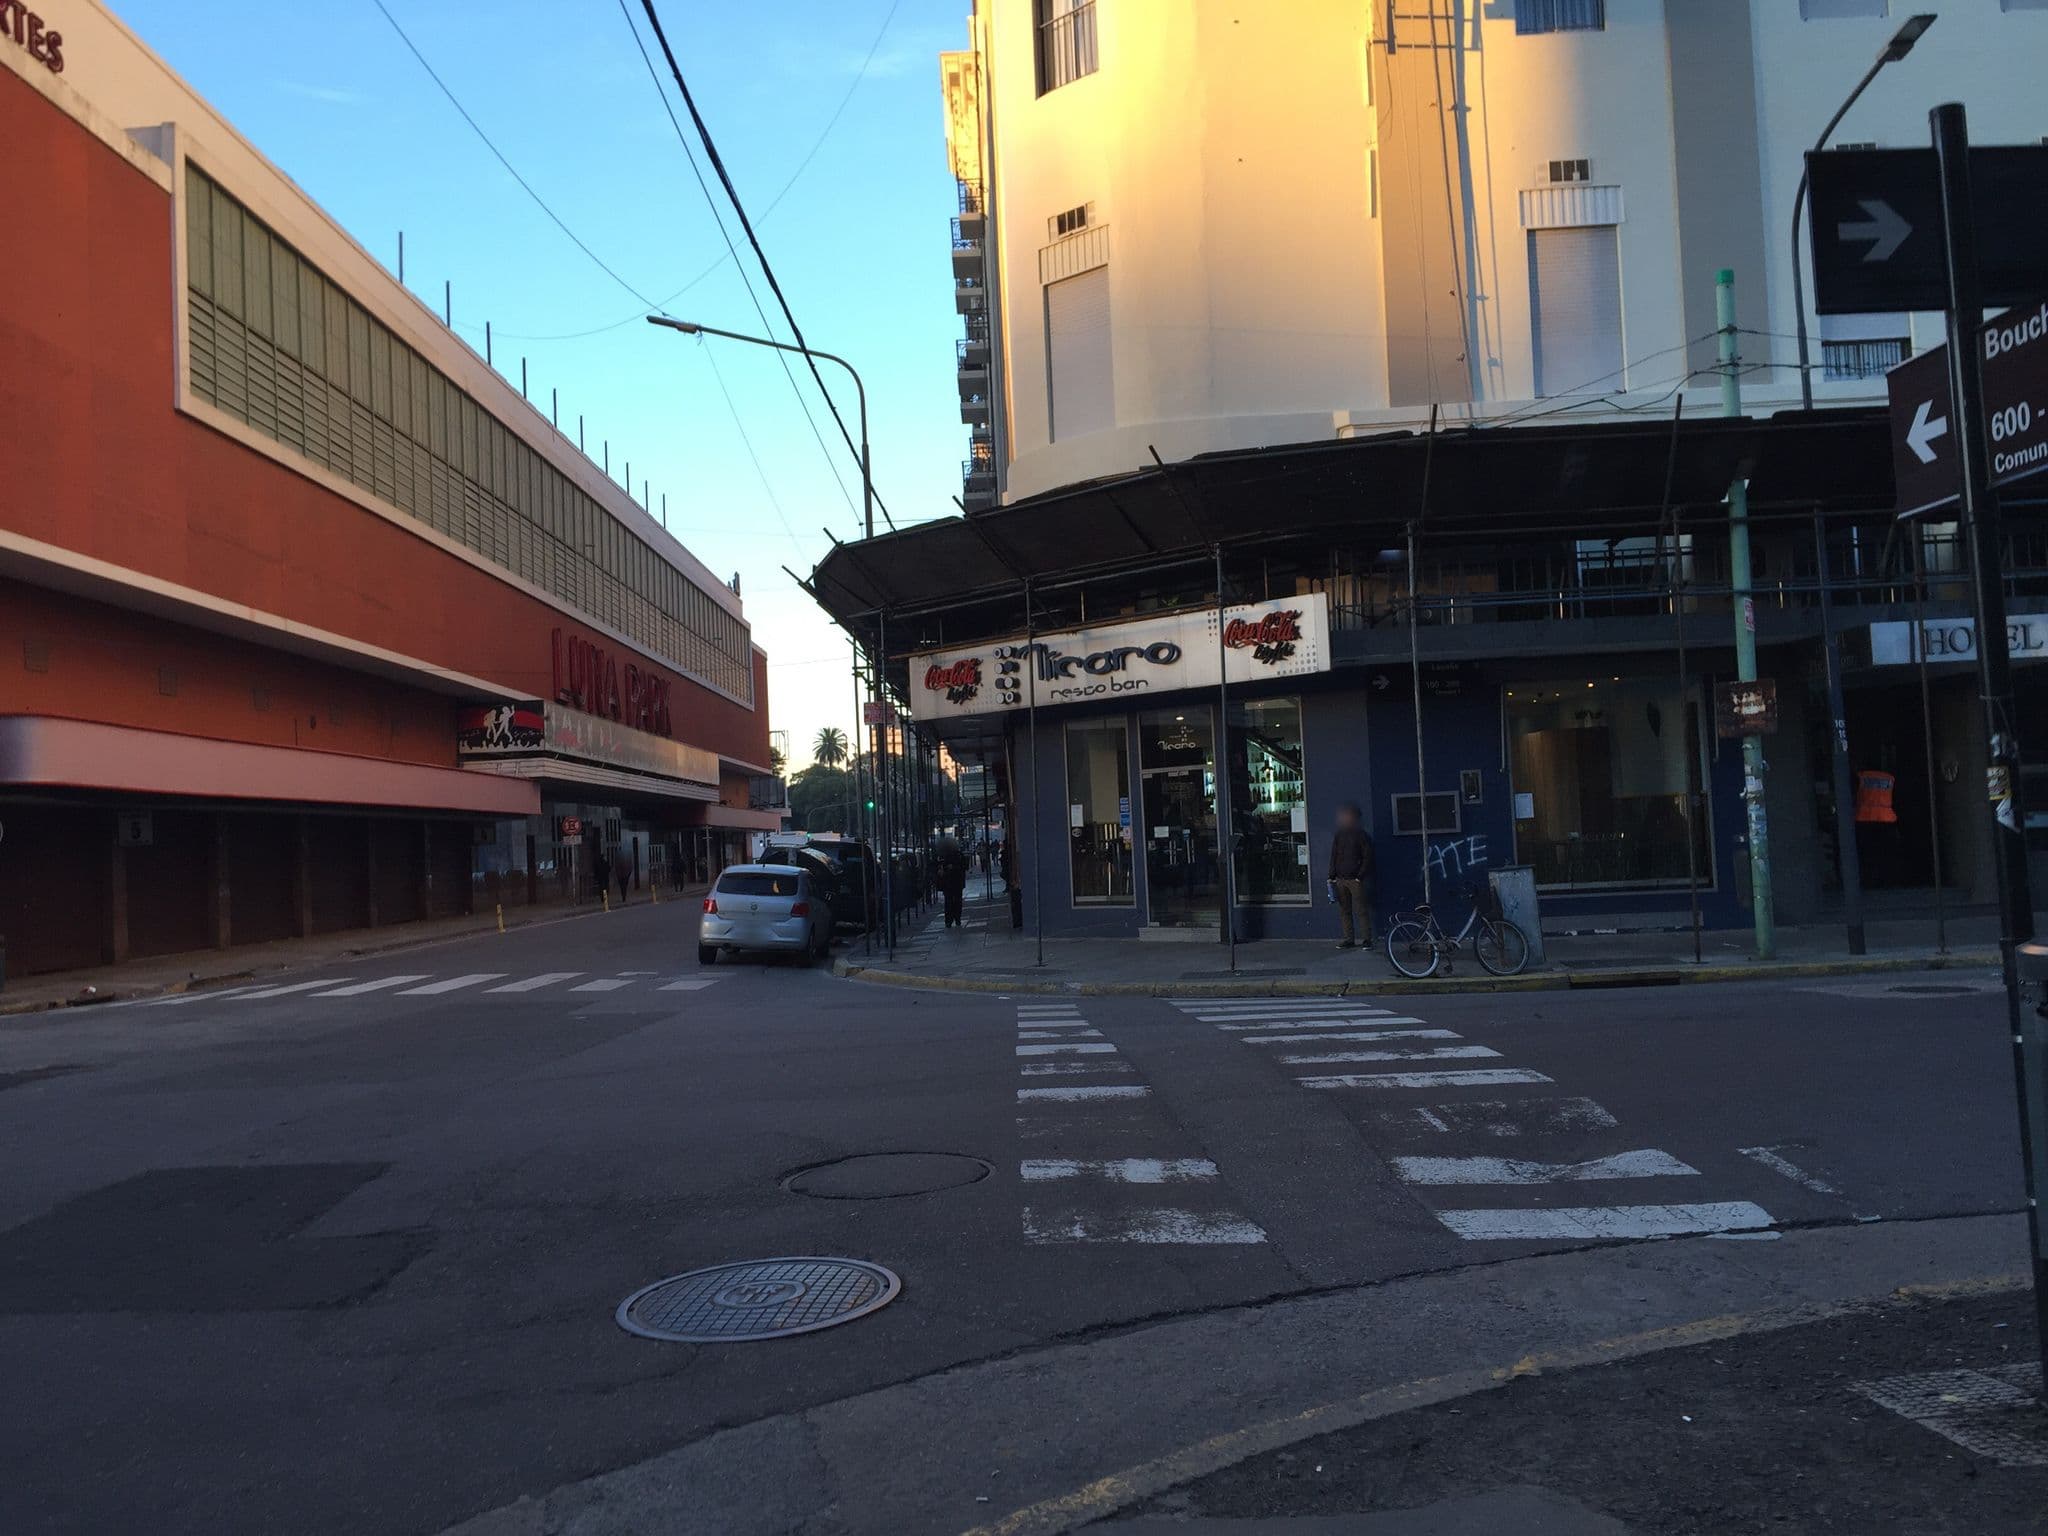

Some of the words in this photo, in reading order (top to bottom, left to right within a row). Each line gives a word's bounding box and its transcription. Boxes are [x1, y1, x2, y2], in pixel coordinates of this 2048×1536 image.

[1991, 401, 2031, 442] 600
[1921, 623, 2044, 656] HOEL
[551, 627, 621, 725] LUNA
[624, 663, 673, 740] PARK
